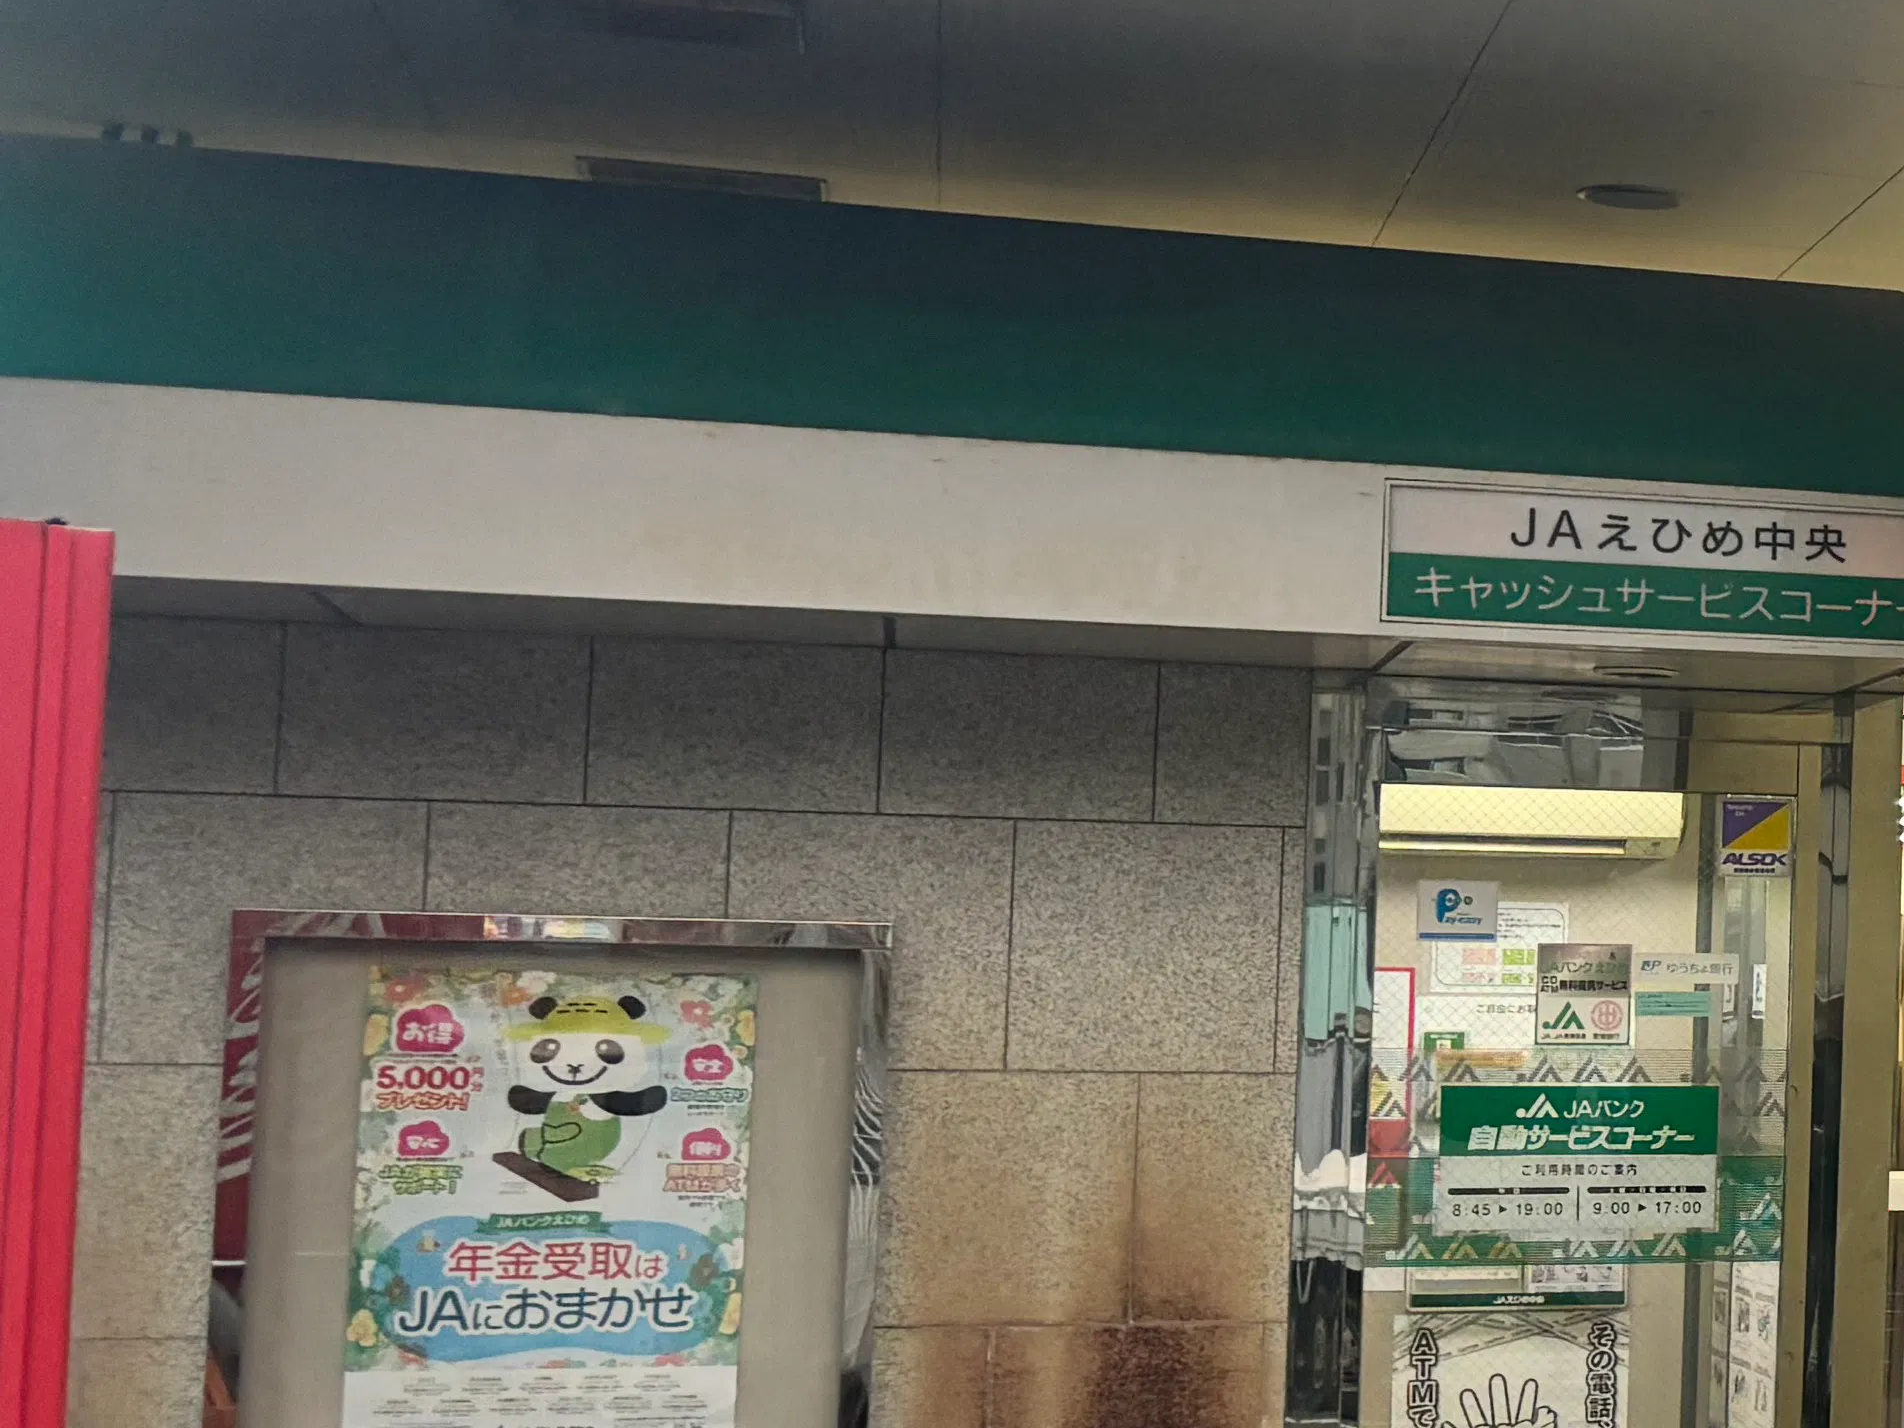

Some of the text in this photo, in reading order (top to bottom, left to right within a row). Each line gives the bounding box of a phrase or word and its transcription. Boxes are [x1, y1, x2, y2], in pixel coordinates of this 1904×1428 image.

[1510, 506, 1847, 564] JAえひめ中央
[1722, 853, 1787, 866] ALSOK
[1666, 962, 1734, 975] ゆうちょ銀行
[1563, 1099, 1646, 1119] JAバンク
[1467, 1125, 1695, 1151] 自動サービスコーナー
[1521, 1164, 1638, 1176] ご利用時間のご案内
[1452, 1200, 1702, 1216] 8:45 19:00 9:00 17:00
[448, 1242, 665, 1282] 年金受取は
[399, 1286, 693, 1333] JAにおまかせ
